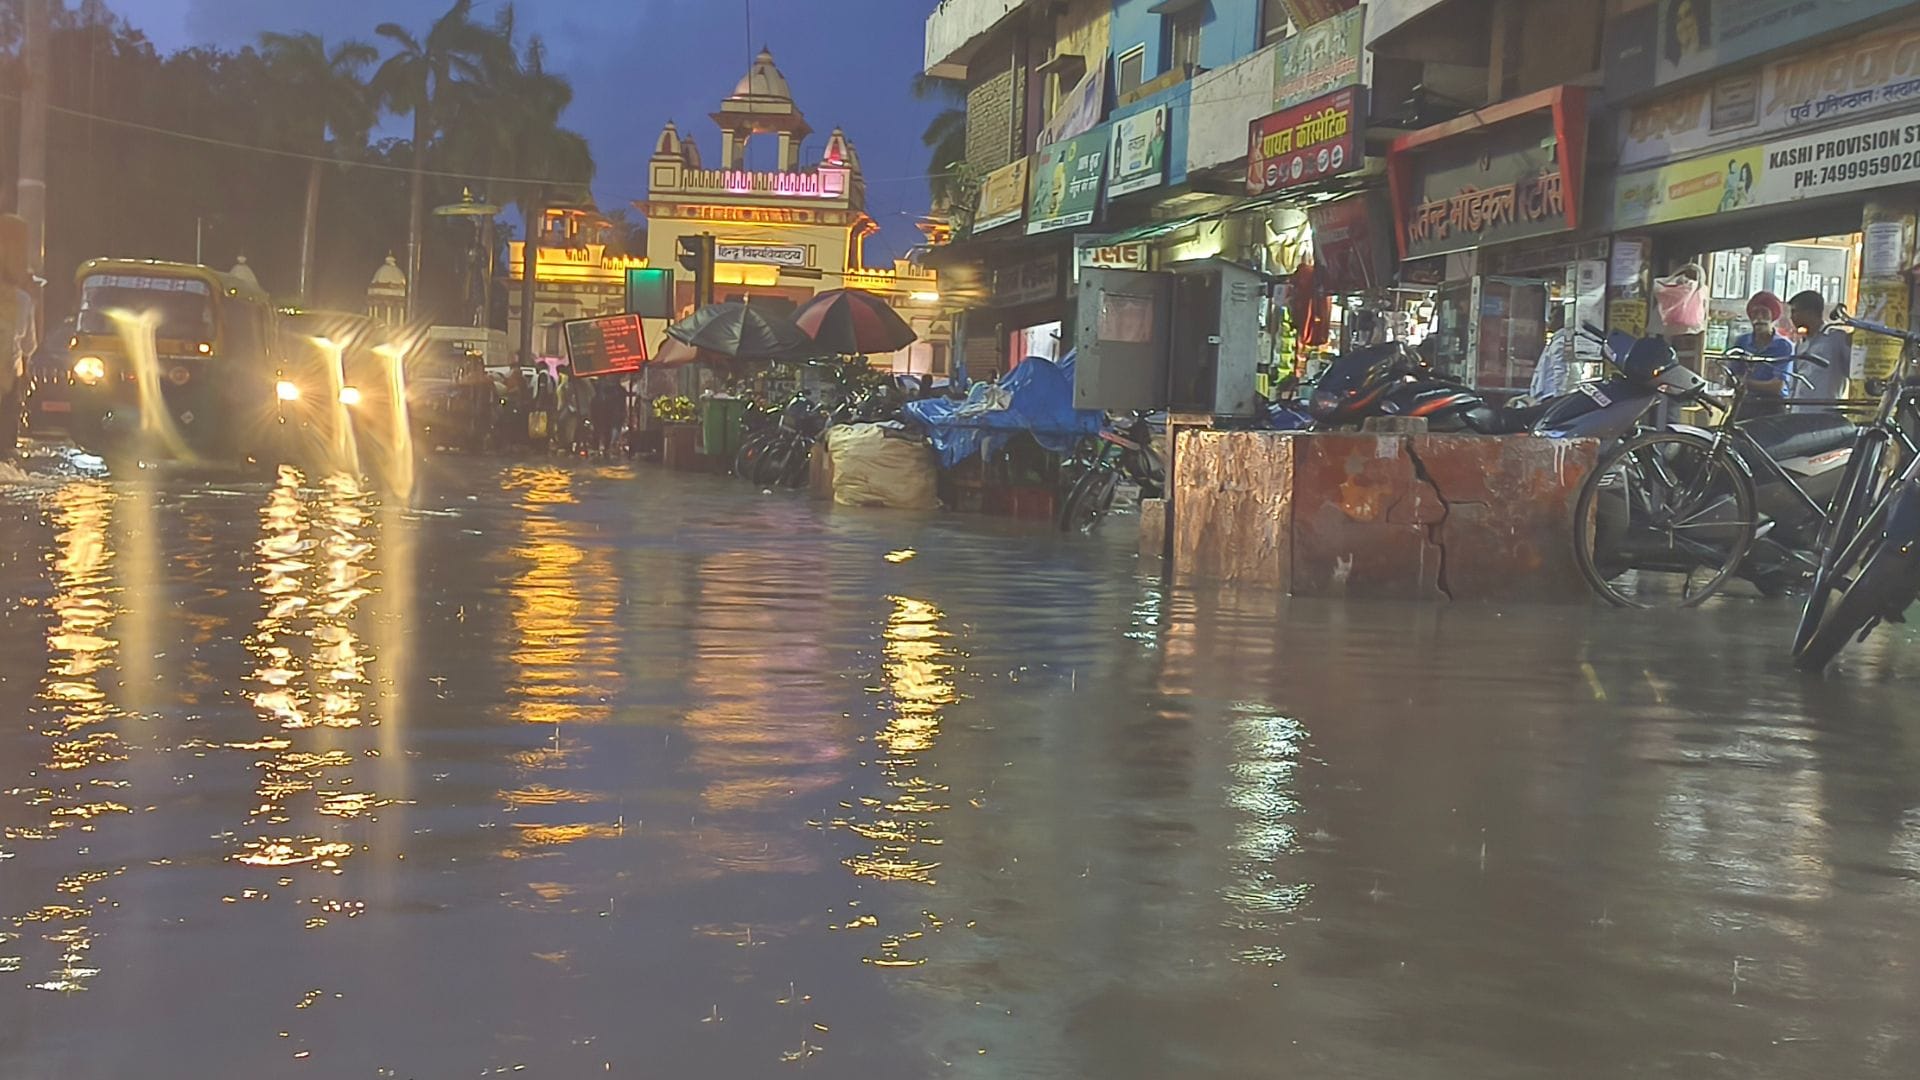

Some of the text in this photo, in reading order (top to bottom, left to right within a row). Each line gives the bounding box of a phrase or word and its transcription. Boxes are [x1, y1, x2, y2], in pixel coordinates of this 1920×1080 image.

[1263, 127, 1293, 158] पायल
[1769, 145, 1813, 169] KASHI
[1816, 128, 1900, 161] PROVISION
[1794, 169, 1818, 189] PH:
